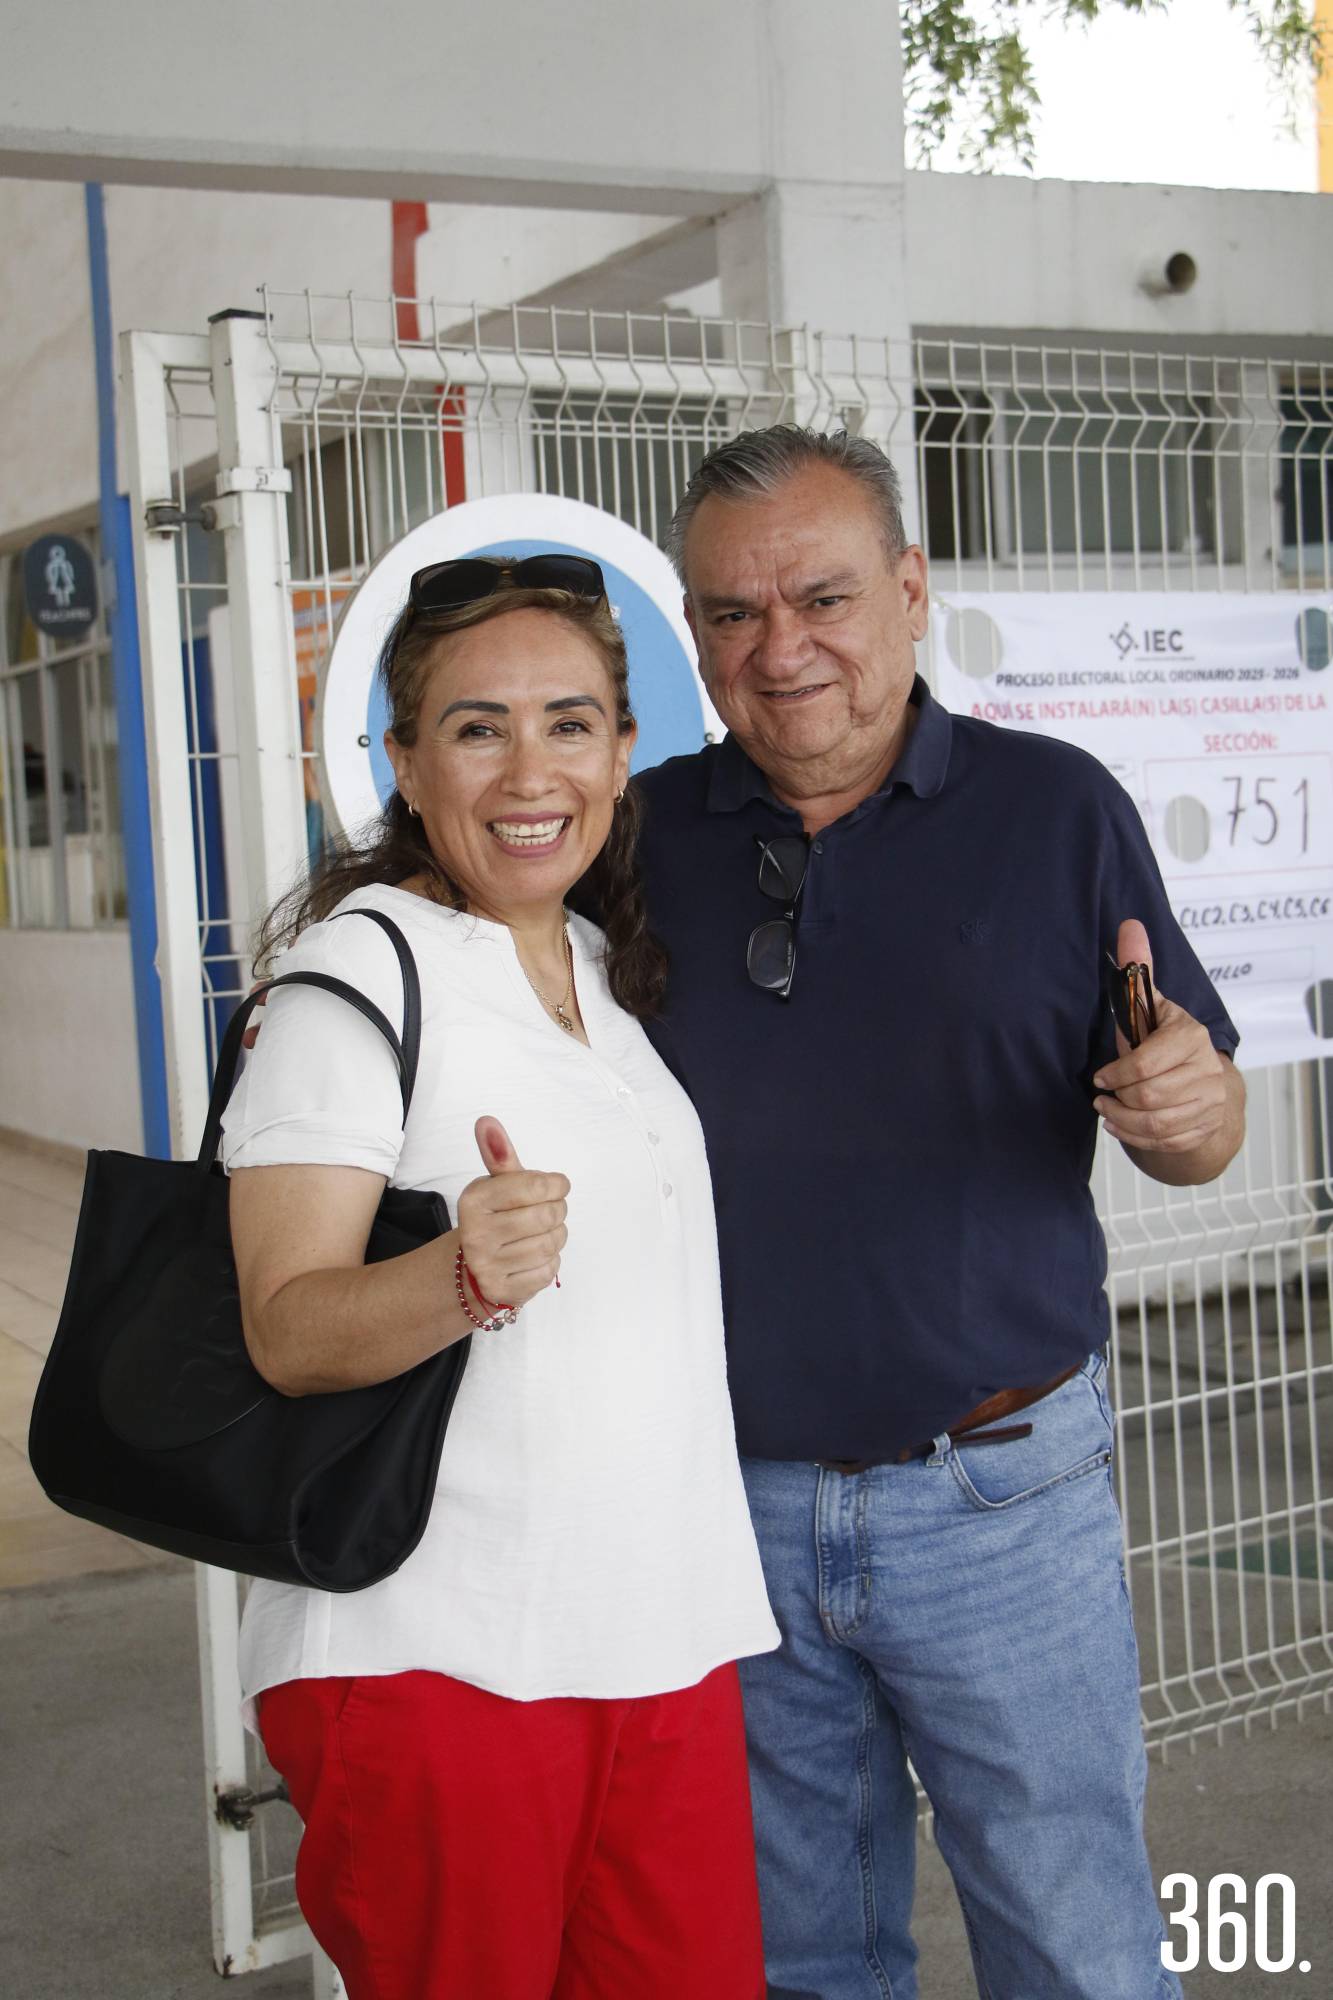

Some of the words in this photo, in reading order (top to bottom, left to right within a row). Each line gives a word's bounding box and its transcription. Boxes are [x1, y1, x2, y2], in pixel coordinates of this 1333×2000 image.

[1144, 629, 1184, 653] IEC
[996, 672, 1055, 687] PROCESO
[1057, 670, 1127, 686] ELECTORAL
[1129, 669, 1166, 685] LOCAL
[1169, 667, 1235, 683] ORDINARIO
[1237, 667, 1265, 682] 2025
[1273, 666, 1300, 681] 2026
[1015, 702, 1035, 721] SE
[1038, 697, 1155, 720] INSTALARÁ(N)
[1159, 696, 1197, 717] LA(S)
[1200, 694, 1281, 715] CASILLA(S)
[1284, 693, 1304, 711] DE
[1307, 692, 1328, 711] LA
[1203, 729, 1278, 753] SECCIÓN:
[1221, 776, 1309, 855] 751
